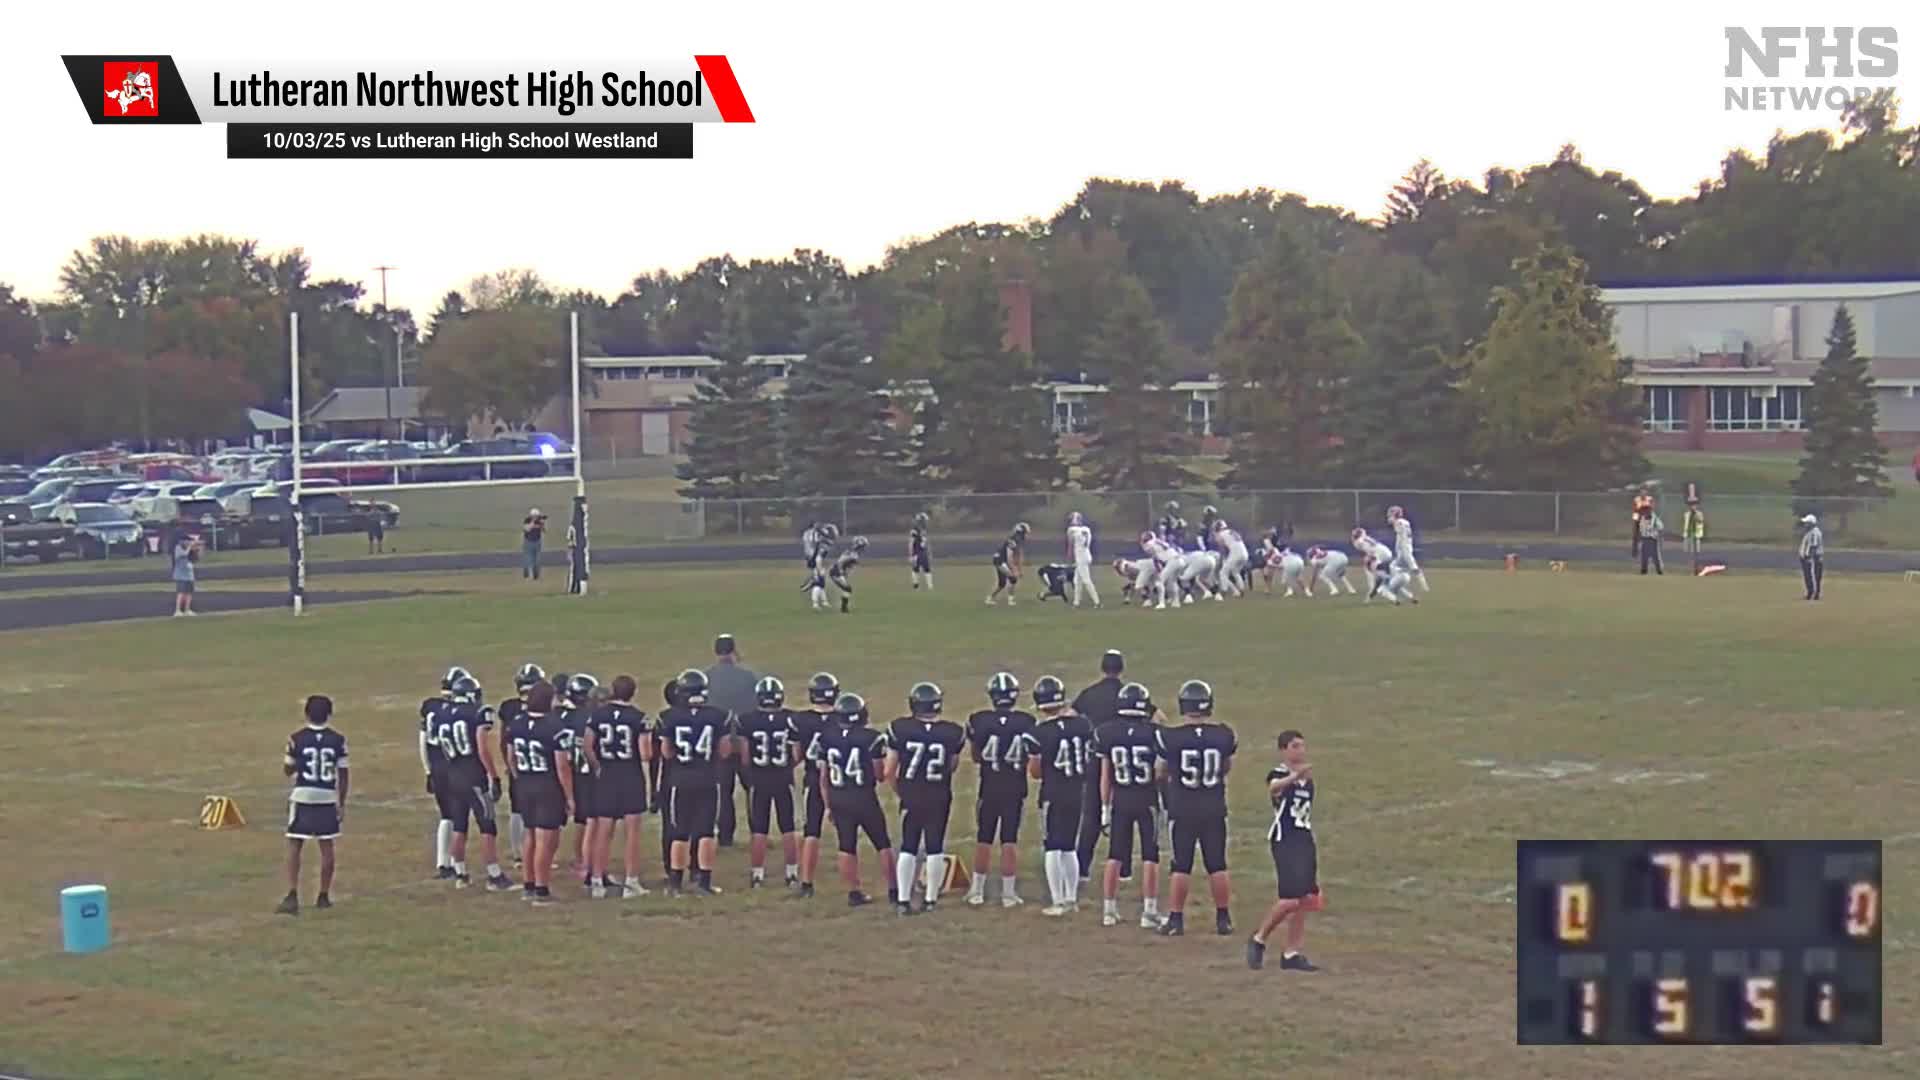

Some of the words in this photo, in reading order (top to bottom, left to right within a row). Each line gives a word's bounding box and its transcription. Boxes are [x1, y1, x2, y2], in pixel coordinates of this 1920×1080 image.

[439, 719, 470, 758] 60
[599, 723, 632, 760] 23
[674, 725, 712, 763] 54
[752, 730, 790, 767] 33
[983, 735, 1022, 772] 44
[1054, 736, 1083, 776] 41
[827, 747, 863, 786] 64
[905, 742, 944, 781] 72
[1112, 746, 1151, 785] 85
[1181, 749, 1220, 788] 50
[201, 797, 224, 828] 20
[1558, 883, 1590, 940] 0
[1848, 882, 1877, 936] 0
[1655, 979, 1687, 1033] 5
[1745, 978, 1776, 1031] 5
